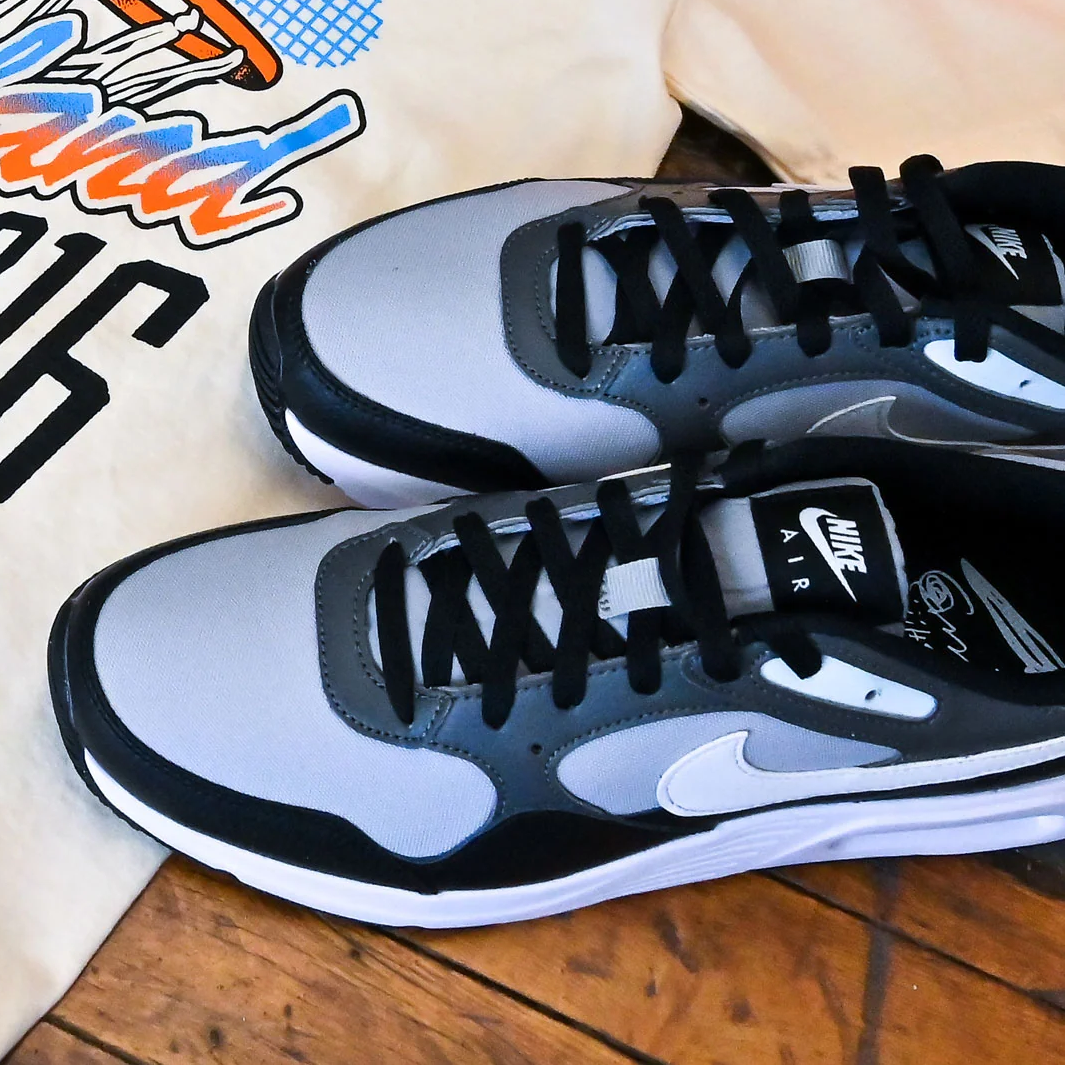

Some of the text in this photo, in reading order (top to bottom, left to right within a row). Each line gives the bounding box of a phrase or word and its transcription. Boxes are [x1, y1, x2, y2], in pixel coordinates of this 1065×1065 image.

[988, 226, 1028, 260] NIKE
[780, 528, 810, 592] AIR
[826, 517, 868, 574] NIKE
